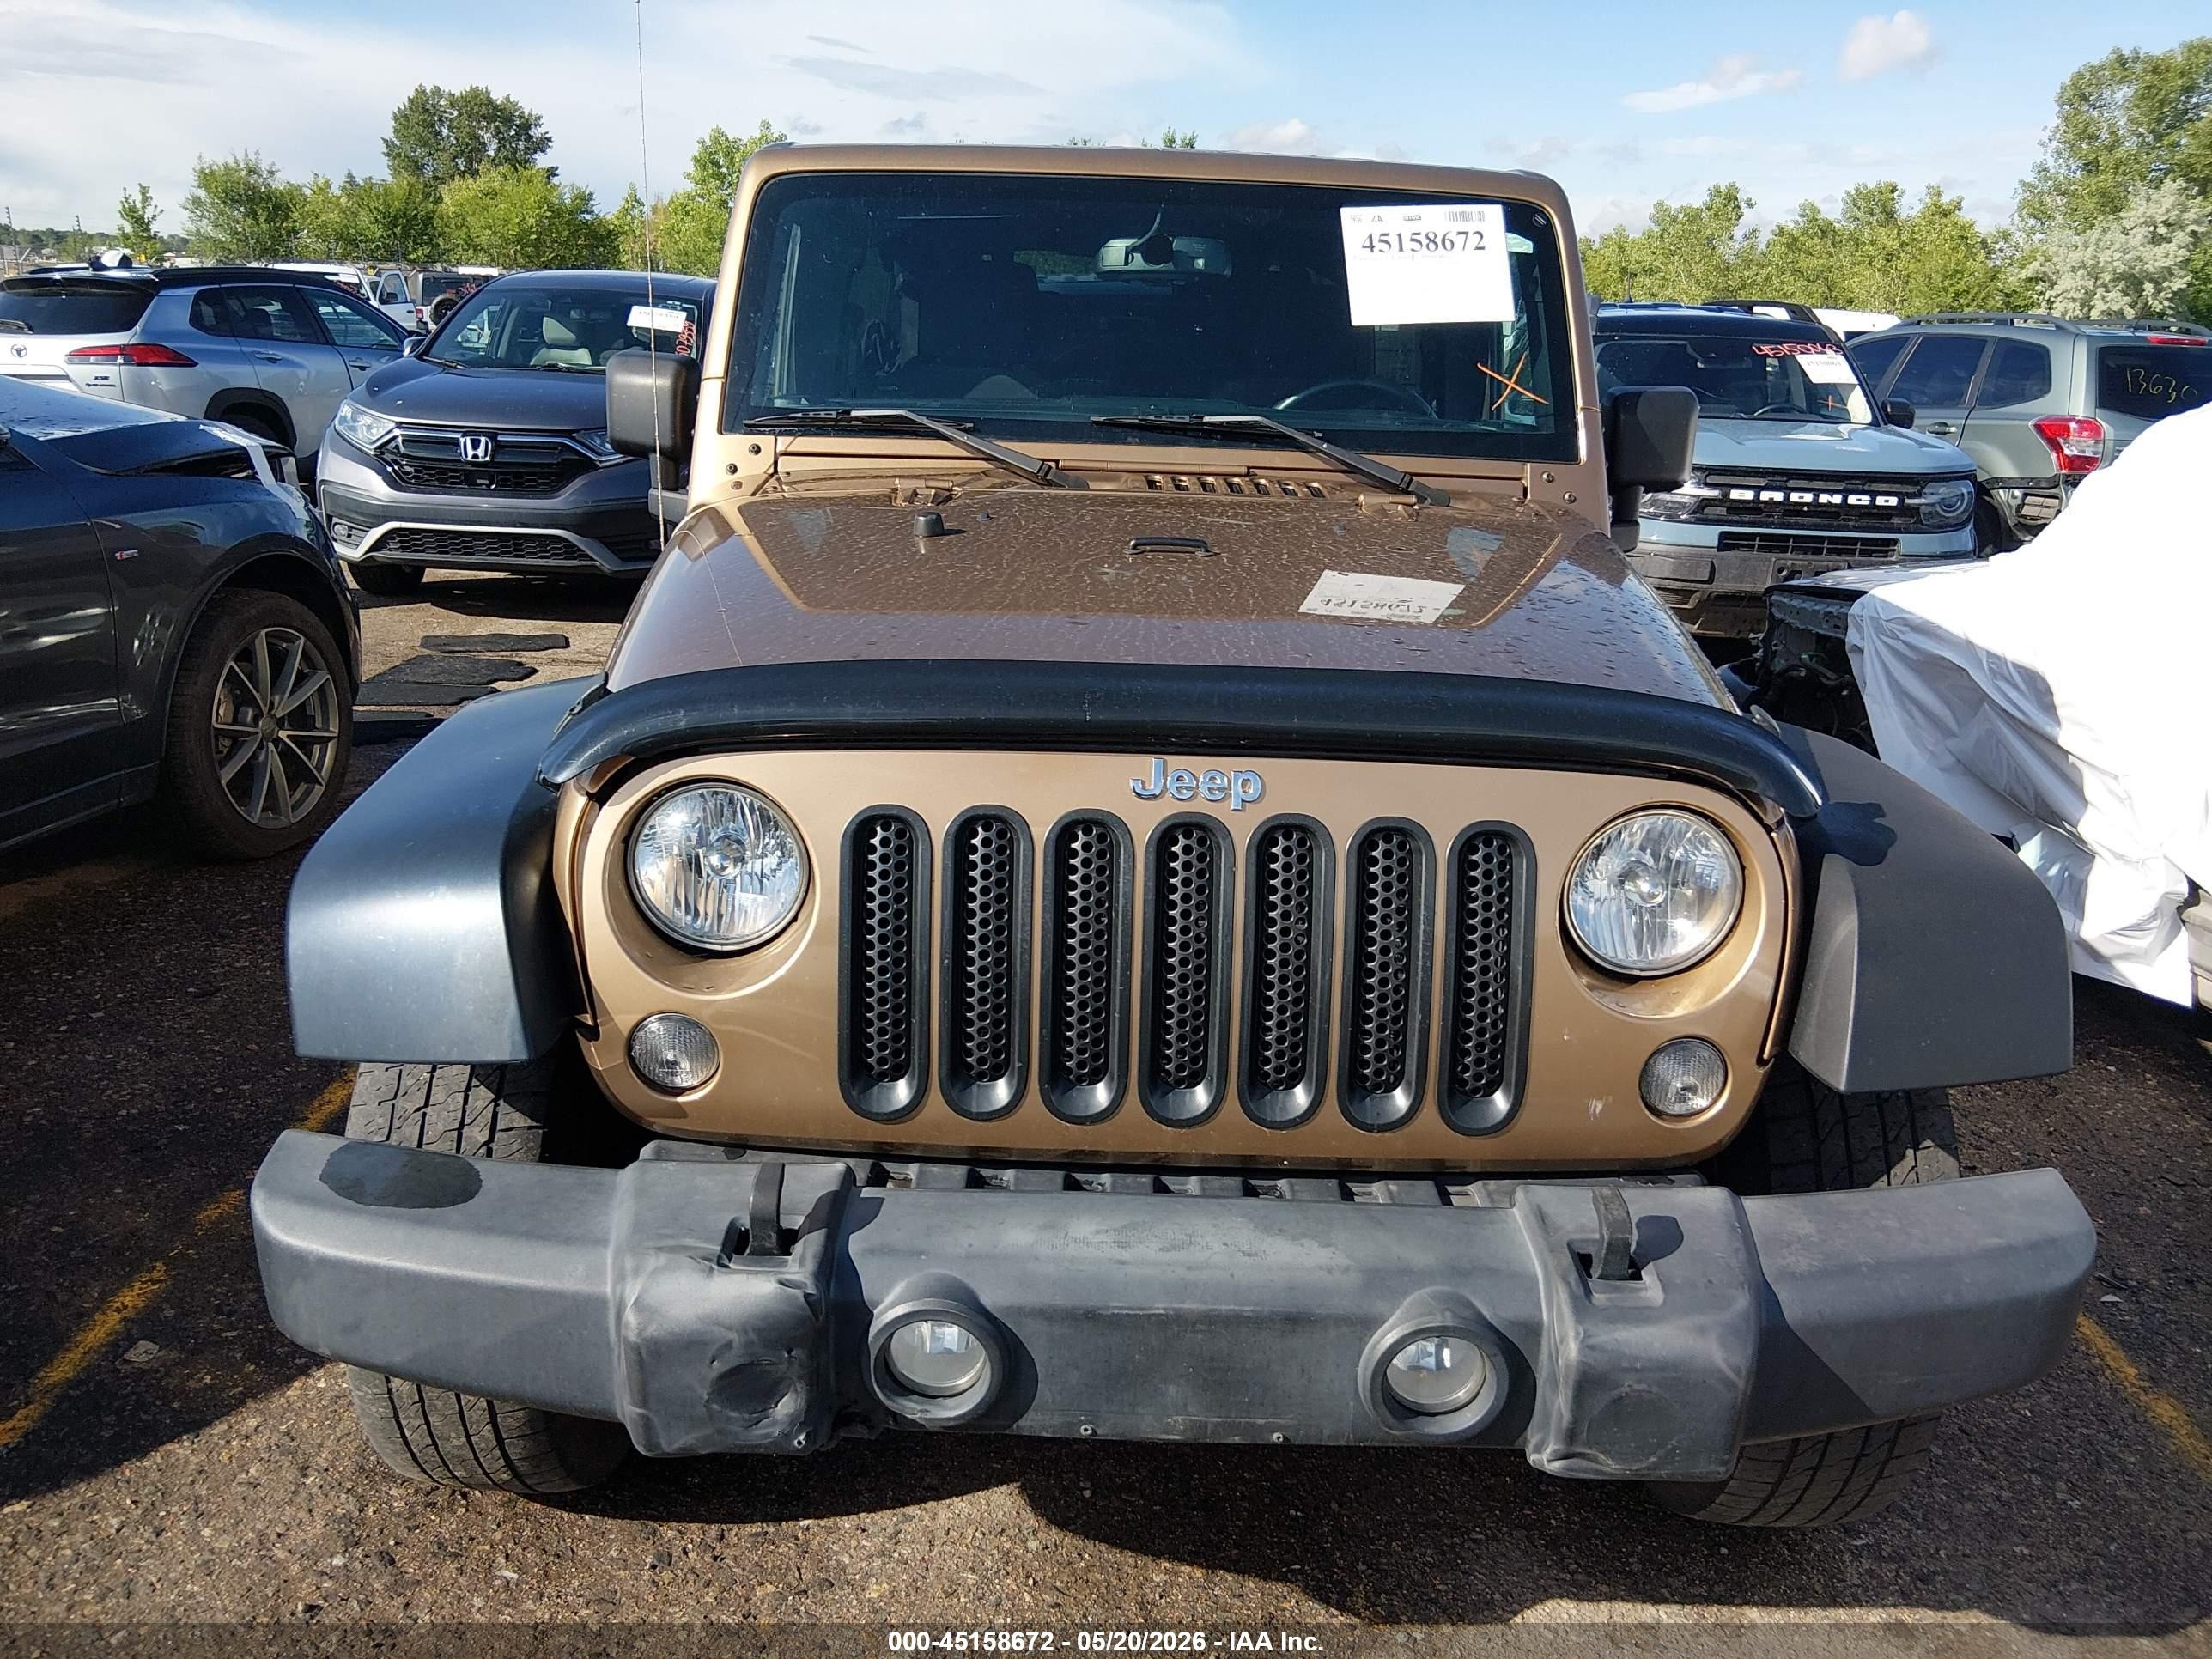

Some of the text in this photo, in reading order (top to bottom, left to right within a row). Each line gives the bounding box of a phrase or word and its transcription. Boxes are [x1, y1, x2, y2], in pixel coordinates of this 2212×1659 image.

[1361, 230, 1486, 253] 45158672
[1729, 489, 1899, 507] BRONCO
[1129, 757, 1262, 811] Jeep
